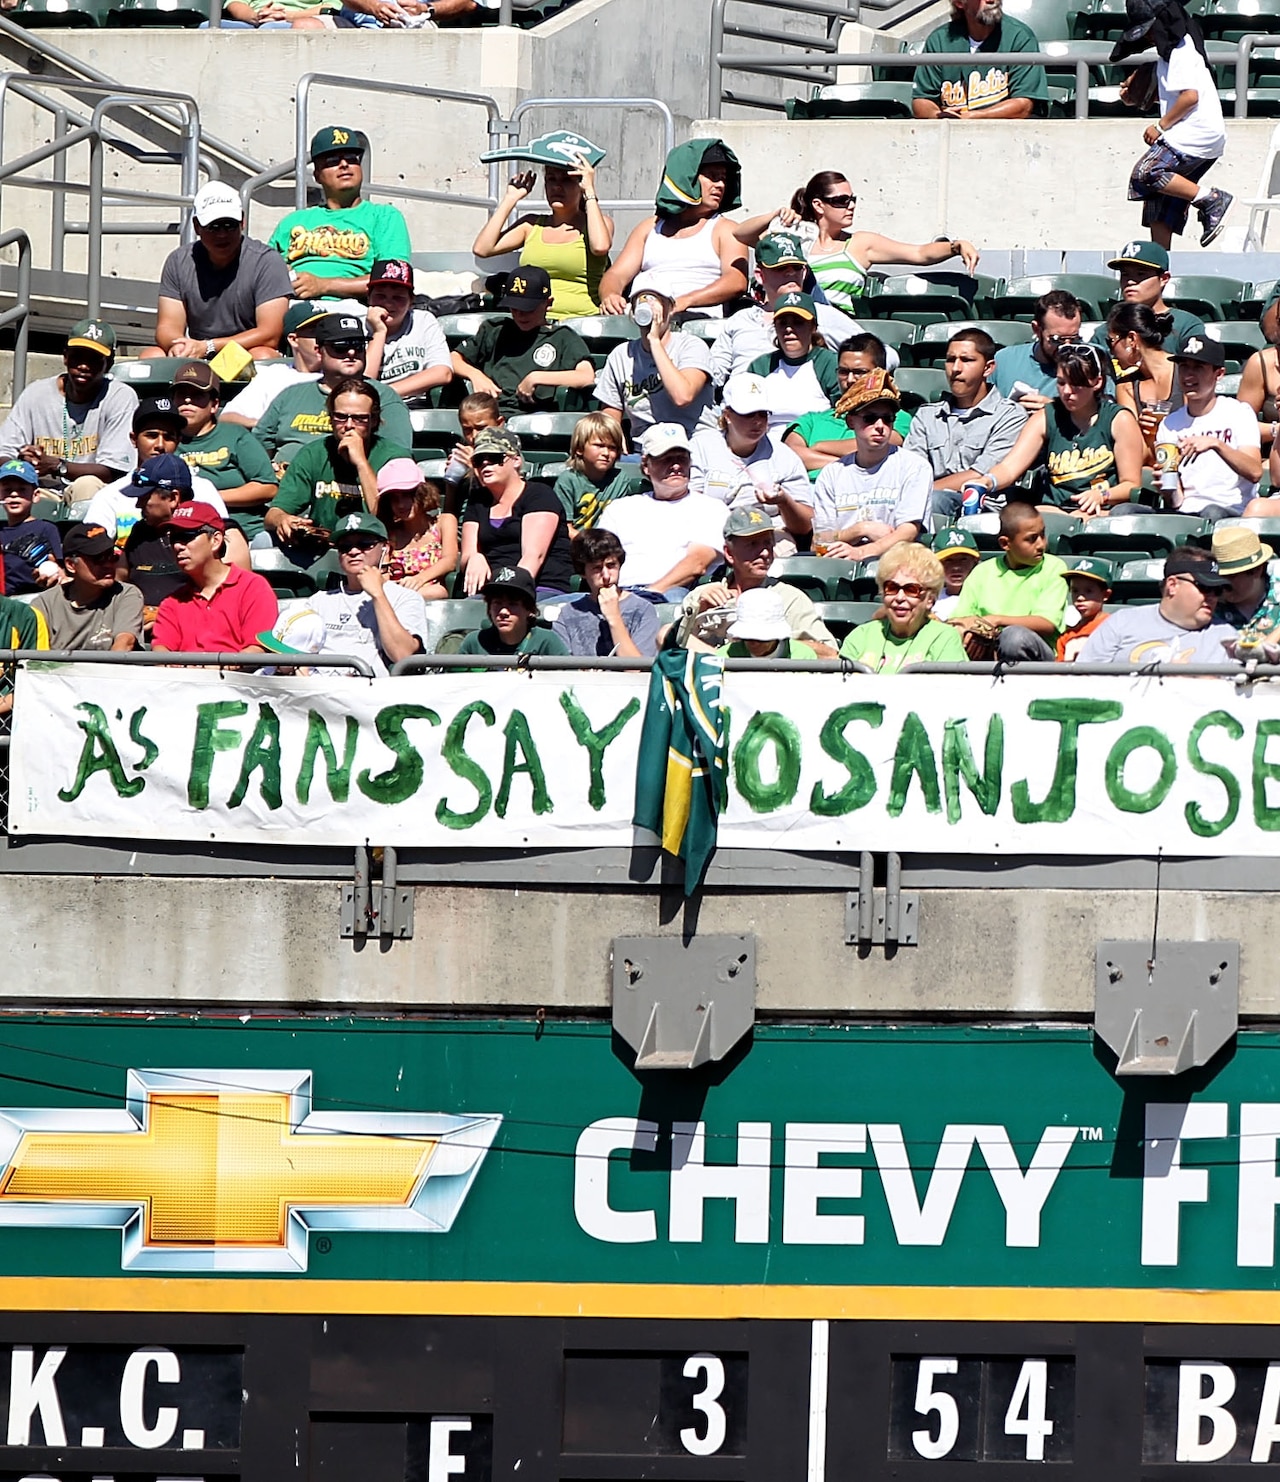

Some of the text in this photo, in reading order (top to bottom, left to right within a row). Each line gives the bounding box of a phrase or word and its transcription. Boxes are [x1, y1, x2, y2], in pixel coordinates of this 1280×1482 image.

[187, 698, 442, 812] FANS
[434, 684, 641, 831] SAY
[720, 706, 802, 815] O
[7, 1345, 205, 1450] K.C.
[679, 1351, 729, 1458] 3
